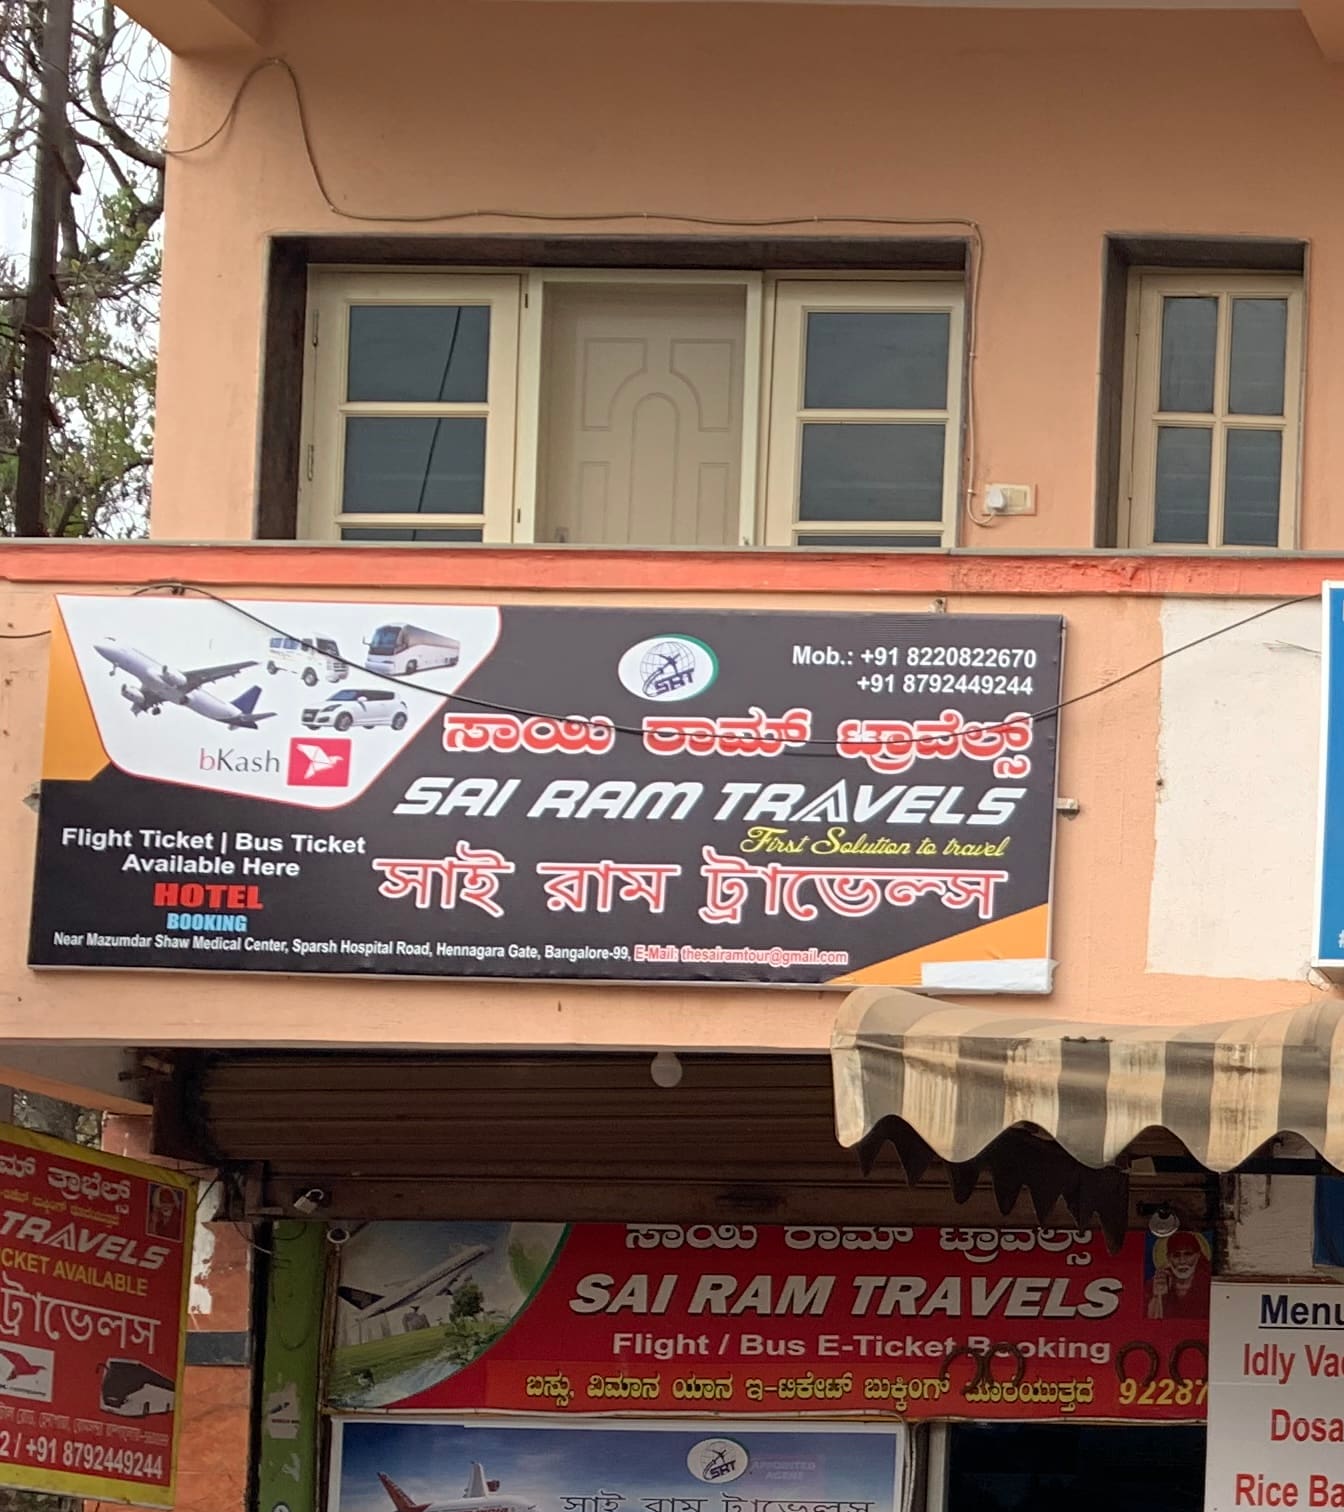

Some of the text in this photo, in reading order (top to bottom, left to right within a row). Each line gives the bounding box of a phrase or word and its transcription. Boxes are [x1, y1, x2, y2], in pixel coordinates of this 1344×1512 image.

[860, 646, 1037, 669] +91 8220822670
[856, 673, 1034, 696] +91 8792449244
[442, 711, 615, 754] ಸಾಯಿ
[641, 706, 812, 756] ರಾಮ್
[198, 746, 281, 777] bKash
[393, 776, 1027, 826] SAI RAM TRAVELS
[61, 828, 366, 855] Flight Ticket Bus Ticket
[740, 826, 1012, 858] First Solution travel
[122, 854, 300, 877] Available Here
[372, 840, 513, 918] সাই
[537, 859, 681, 914] রাম
[153, 883, 263, 910] HOTEL
[167, 913, 247, 932] BOOKING
[53, 932, 631, 963] Near Mazumdar Shaw Medical Center, Sparsh Hospital Road, Hennagara Gate, Bangalore-99,
[0, 1210, 171, 1270] TRAVELS
[53, 1260, 149, 1297] AVAILABLE
[568, 1273, 1124, 1321] SAI RAM TRAVELS
[613, 1332, 954, 1359] Flight Bus E-Ticket
[1243, 1343, 1295, 1385] Idly
[1270, 1409, 1344, 1443] Dosa
[26, 1436, 163, 1480] +91 8792449244
[1235, 1473, 1299, 1507] Rice
